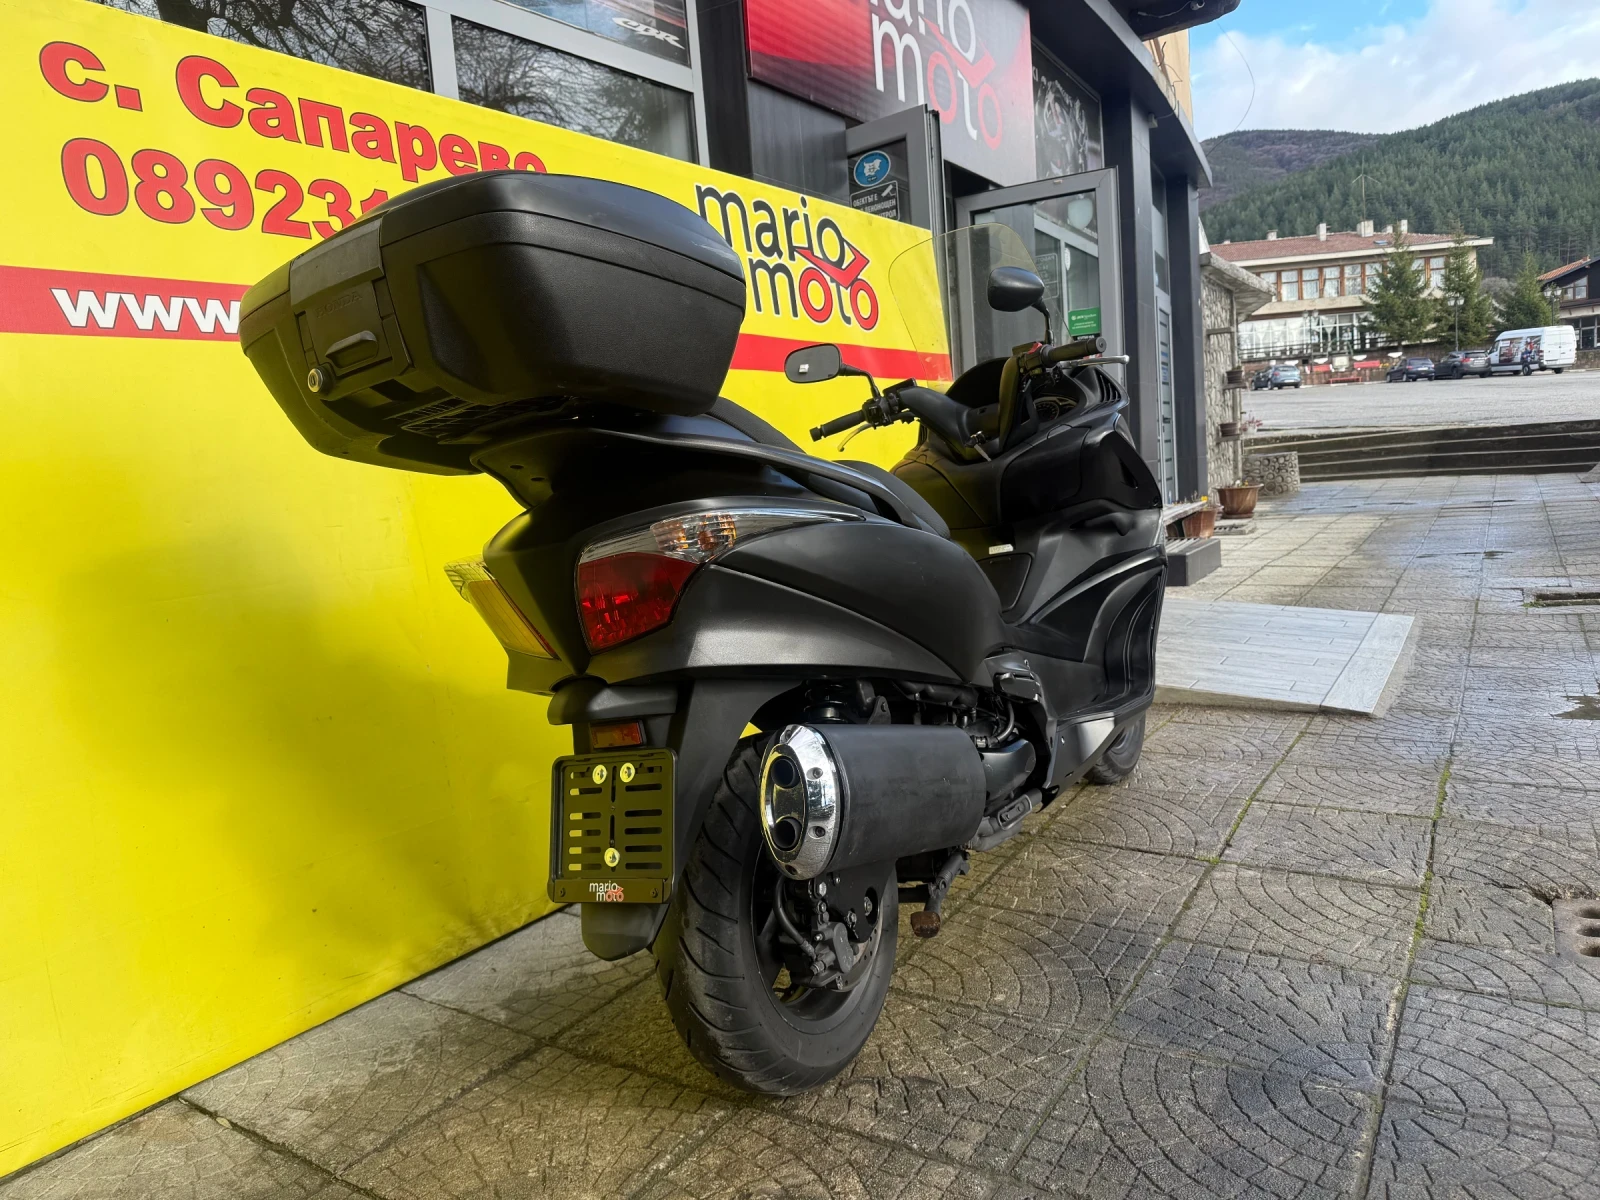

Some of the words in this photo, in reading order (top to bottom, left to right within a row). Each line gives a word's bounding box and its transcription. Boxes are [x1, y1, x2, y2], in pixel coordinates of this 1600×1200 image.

[612, 17, 685, 50] CBR
[39, 41, 143, 112] с.
[872, 13, 1003, 151] moto
[695, 184, 846, 271] mario
[748, 257, 879, 331] moto
[589, 880, 618, 892] mario
[596, 890, 624, 902] moto
